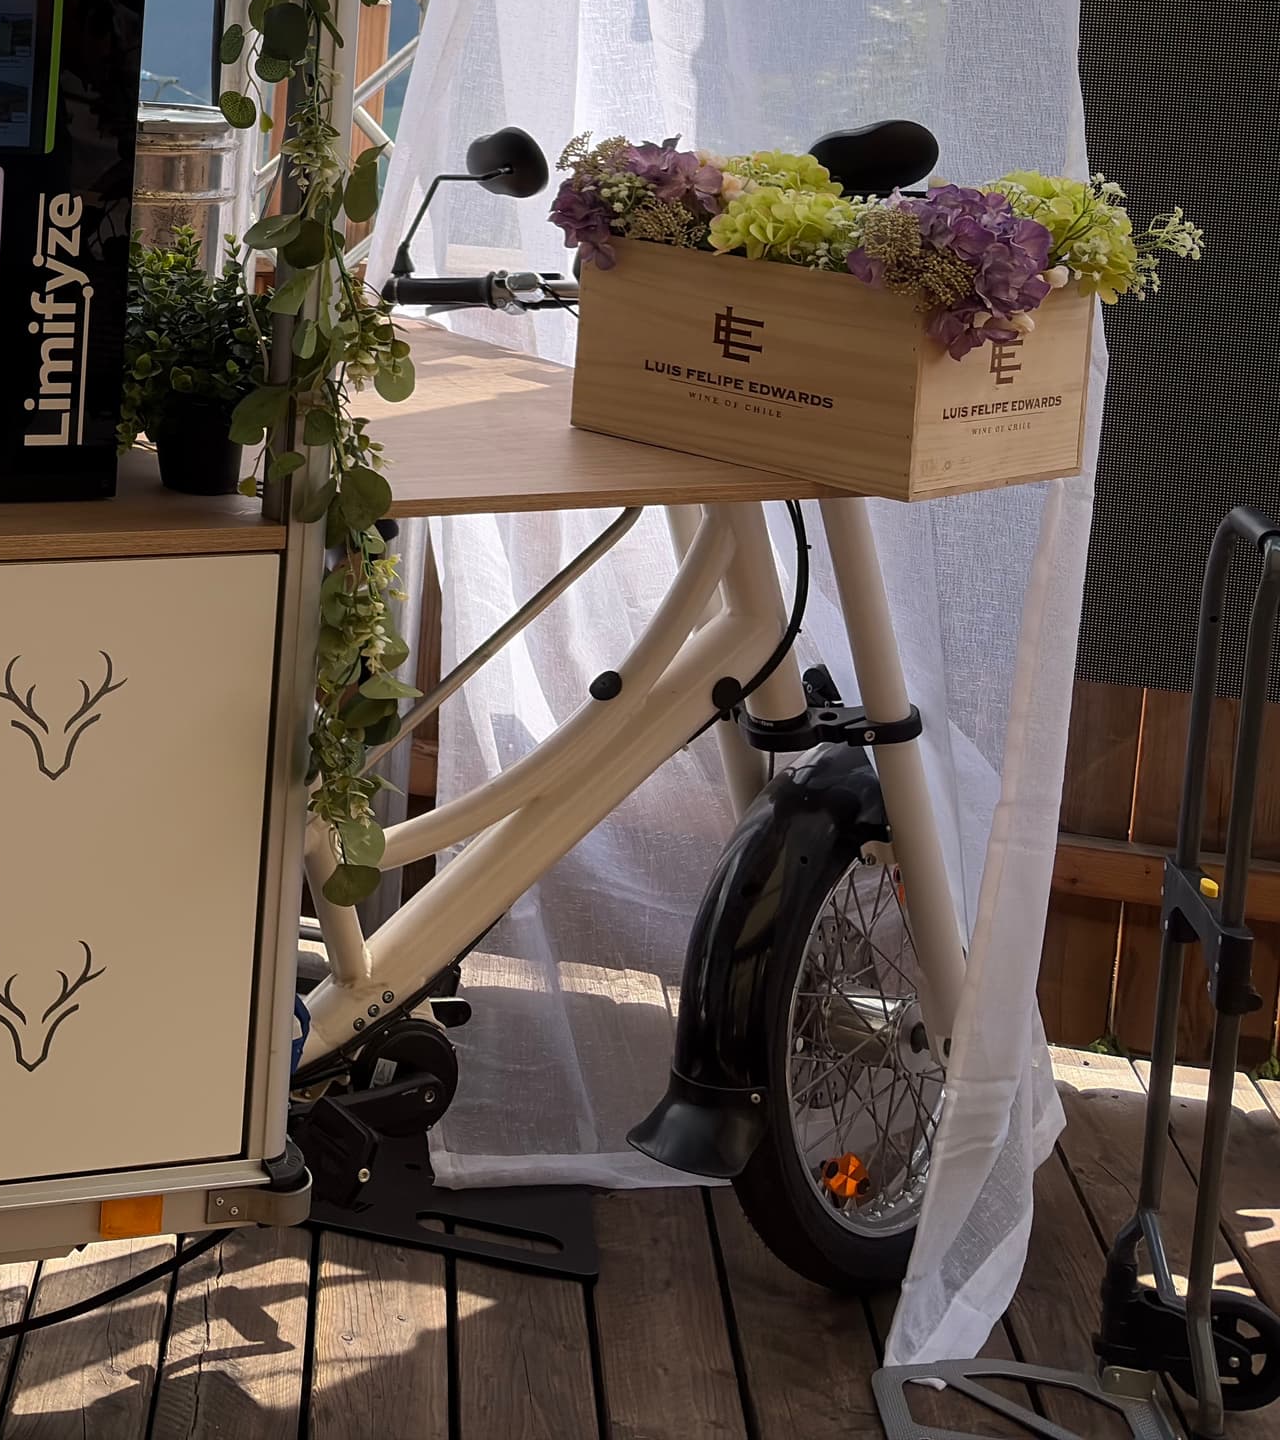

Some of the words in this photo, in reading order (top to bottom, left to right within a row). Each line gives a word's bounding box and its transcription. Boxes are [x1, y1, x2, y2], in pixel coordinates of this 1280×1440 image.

[24, 193, 90, 446] Limifyze
[644, 359, 682, 377] LUIS
[686, 368, 744, 391] FELIPE
[748, 381, 834, 409] EDWARDS
[688, 391, 719, 405] WINE
[724, 399, 738, 409] OF
[744, 404, 782, 418] CHILE
[942, 406, 969, 420] LUIS
[971, 401, 1009, 416] FELIPE
[1011, 395, 1062, 411] EDWARDS
